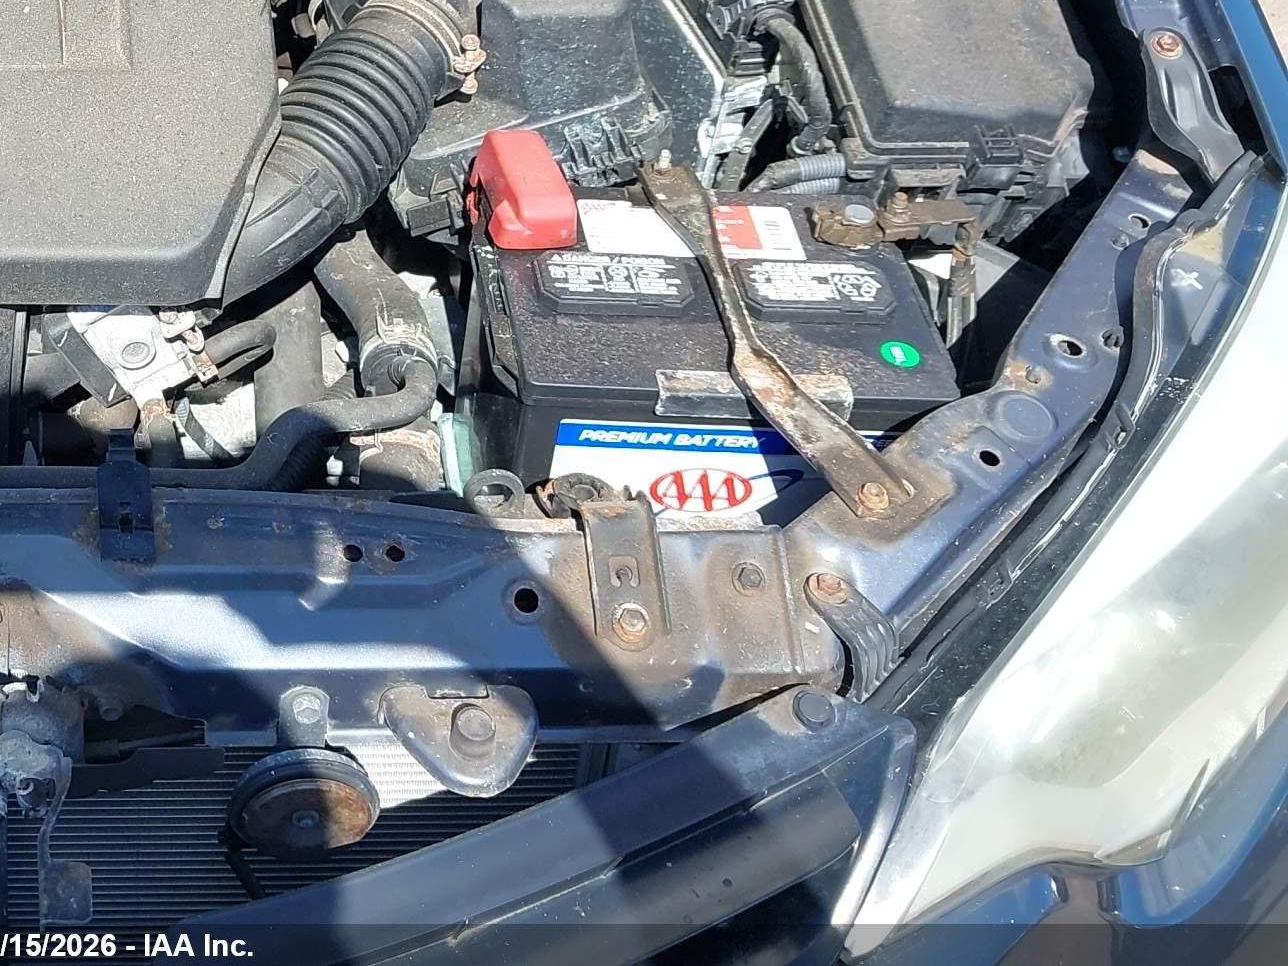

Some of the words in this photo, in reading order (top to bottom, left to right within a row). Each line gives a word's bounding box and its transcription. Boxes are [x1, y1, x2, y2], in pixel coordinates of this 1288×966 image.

[578, 429, 671, 446] PREMIUM
[673, 432, 768, 450] BATTERY
[660, 468, 746, 512] AAA
